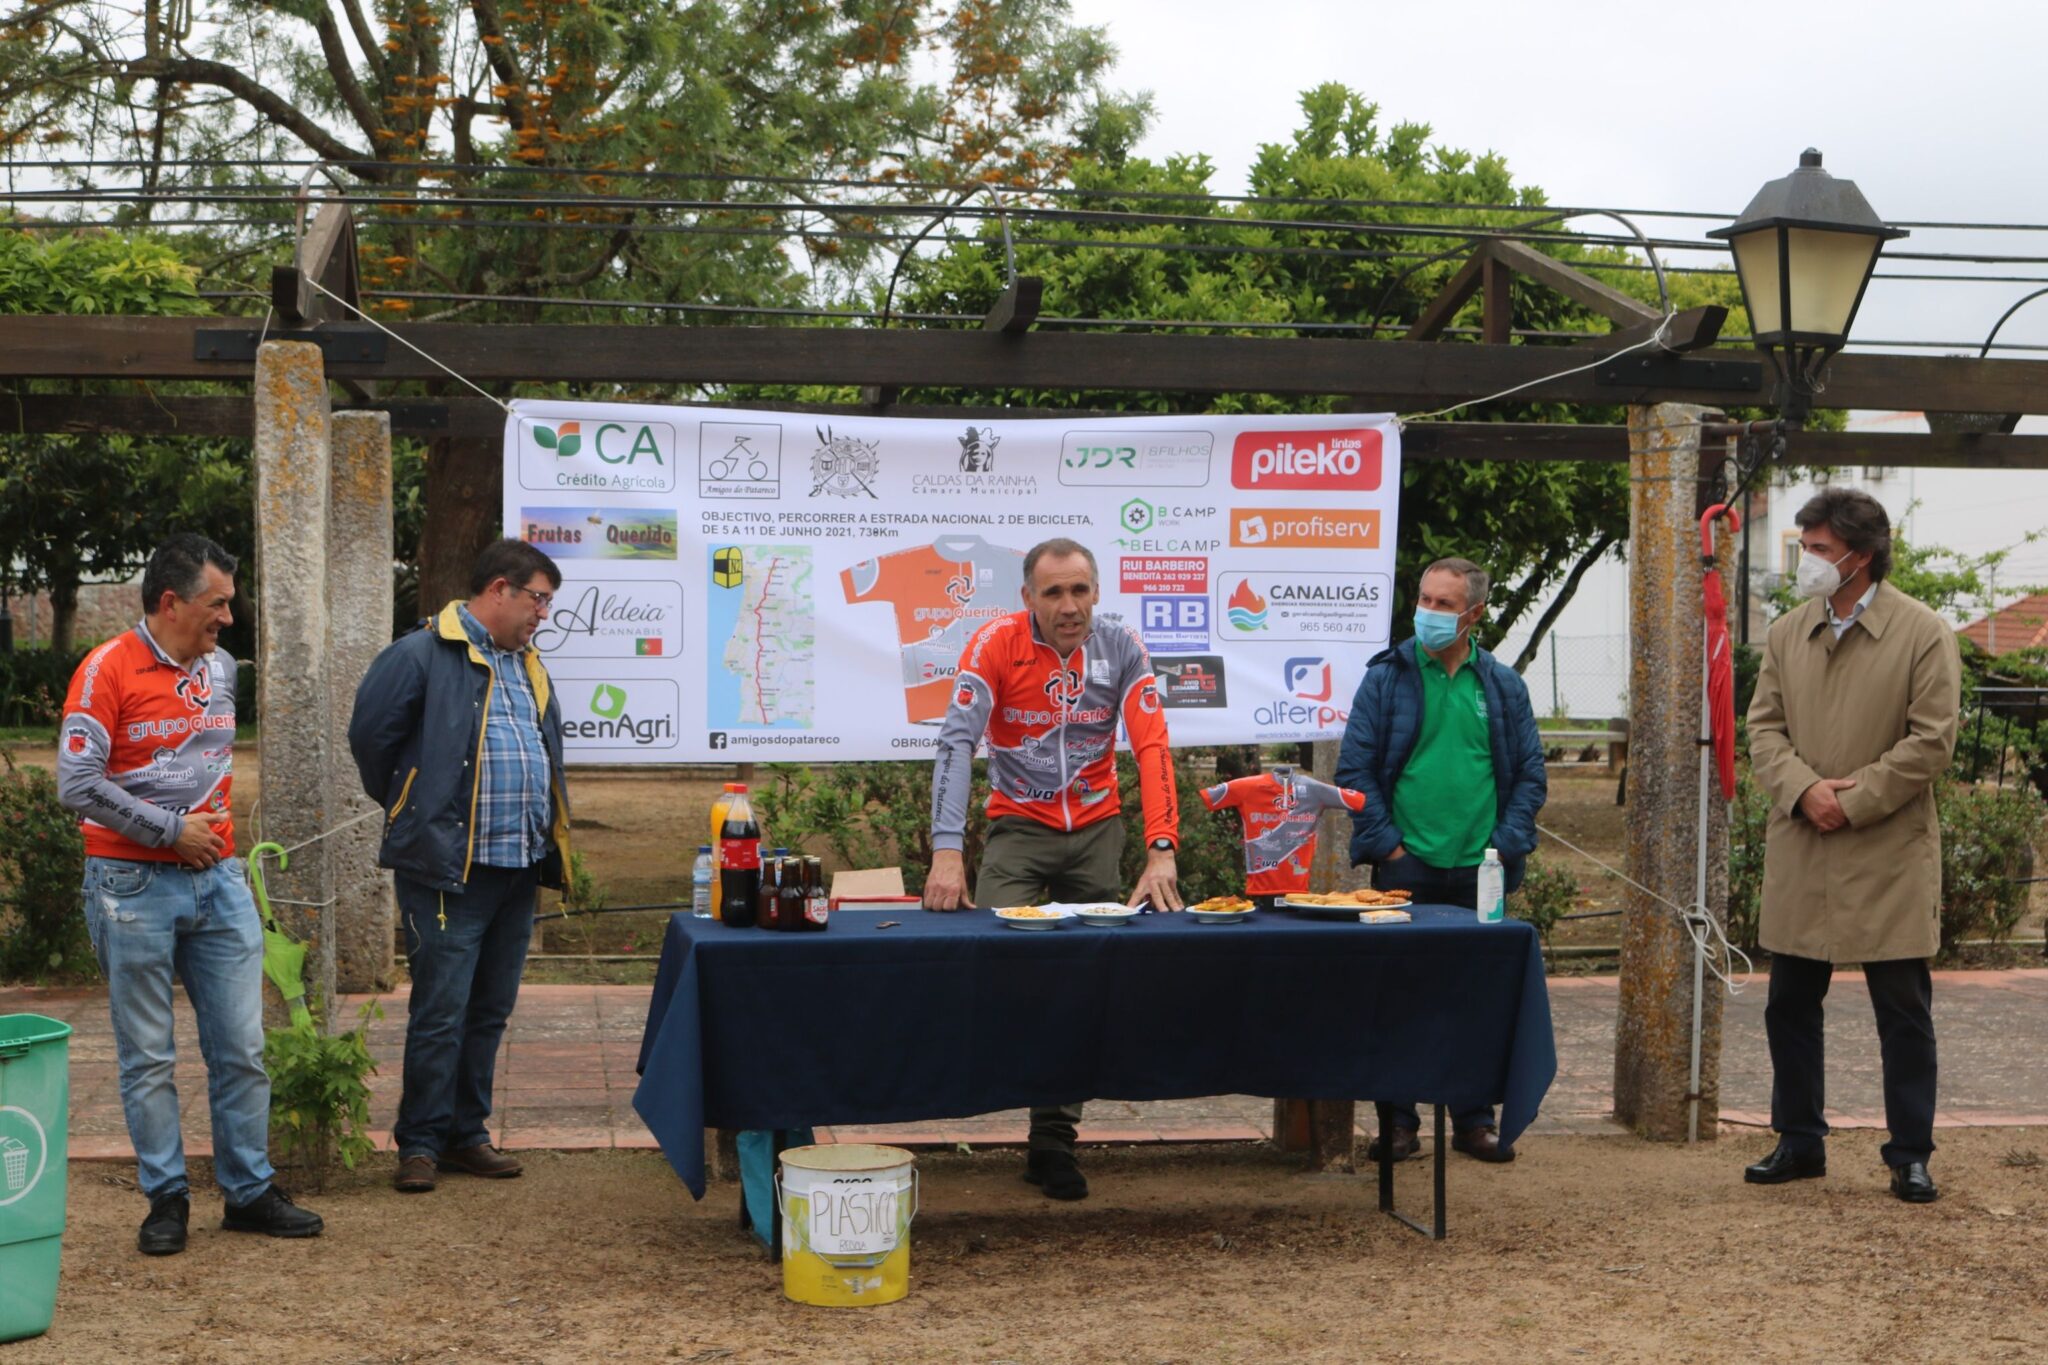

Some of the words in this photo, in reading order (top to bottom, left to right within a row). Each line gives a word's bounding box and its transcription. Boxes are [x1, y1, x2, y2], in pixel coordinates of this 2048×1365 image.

[595, 423, 664, 465] CA
[1332, 438, 1361, 449] tintas
[1065, 447, 1136, 468] JDR
[1250, 442, 1361, 483] piteko
[556, 472, 607, 487] Crédito
[611, 474, 665, 490] Agrícola
[912, 474, 962, 486] CALDAS
[965, 474, 984, 486] DA
[988, 474, 1037, 487] RAINHA
[705, 484, 733, 495] Amigos
[735, 484, 743, 494] do
[744, 485, 776, 494] Patareco
[912, 486, 961, 494] Câmara
[971, 487, 1037, 496] Municipal
[701, 511, 775, 524] OBJECTIVO,
[778, 512, 856, 523] PERCORRER
[858, 514, 868, 523] A
[870, 514, 929, 524] ESTRADA
[932, 514, 995, 524] NACIONAL
[998, 515, 1005, 524] 2
[1008, 515, 1025, 524] DE
[1028, 515, 1094, 526] BICICLETA,
[1158, 506, 1168, 517] B
[1172, 507, 1217, 518] CAMP
[527, 523, 582, 544] Frutas
[606, 524, 672, 545] Querido
[702, 525, 719, 535] DE
[722, 525, 729, 534] 5
[732, 526, 741, 535] A
[744, 526, 755, 535] 11
[759, 526, 777, 536] DE
[780, 527, 822, 537] JUNHO
[825, 527, 856, 538] 2021,
[1272, 516, 1371, 541] profiserv
[1130, 538, 1221, 552] BELCAMP
[1122, 560, 1143, 571] RUI
[1145, 560, 1206, 571] BARBEIRO
[1122, 572, 1161, 580] BENEDITA
[1270, 583, 1379, 601] CANALIGÁS
[532, 586, 664, 652] Aldeia
[953, 605, 1008, 620] Querido
[1145, 601, 1206, 627] RB
[601, 627, 663, 636] CANNABIS
[1300, 622, 1320, 632] 965
[1323, 623, 1343, 633] 560
[1345, 623, 1366, 633] 470
[1002, 706, 1050, 728] grupo
[128, 717, 189, 742] grupo
[562, 714, 671, 744] eenAgri
[731, 734, 840, 746] amigosdopatareco
[891, 738, 939, 748] OBRIGA
[1027, 787, 1055, 800] IVO
